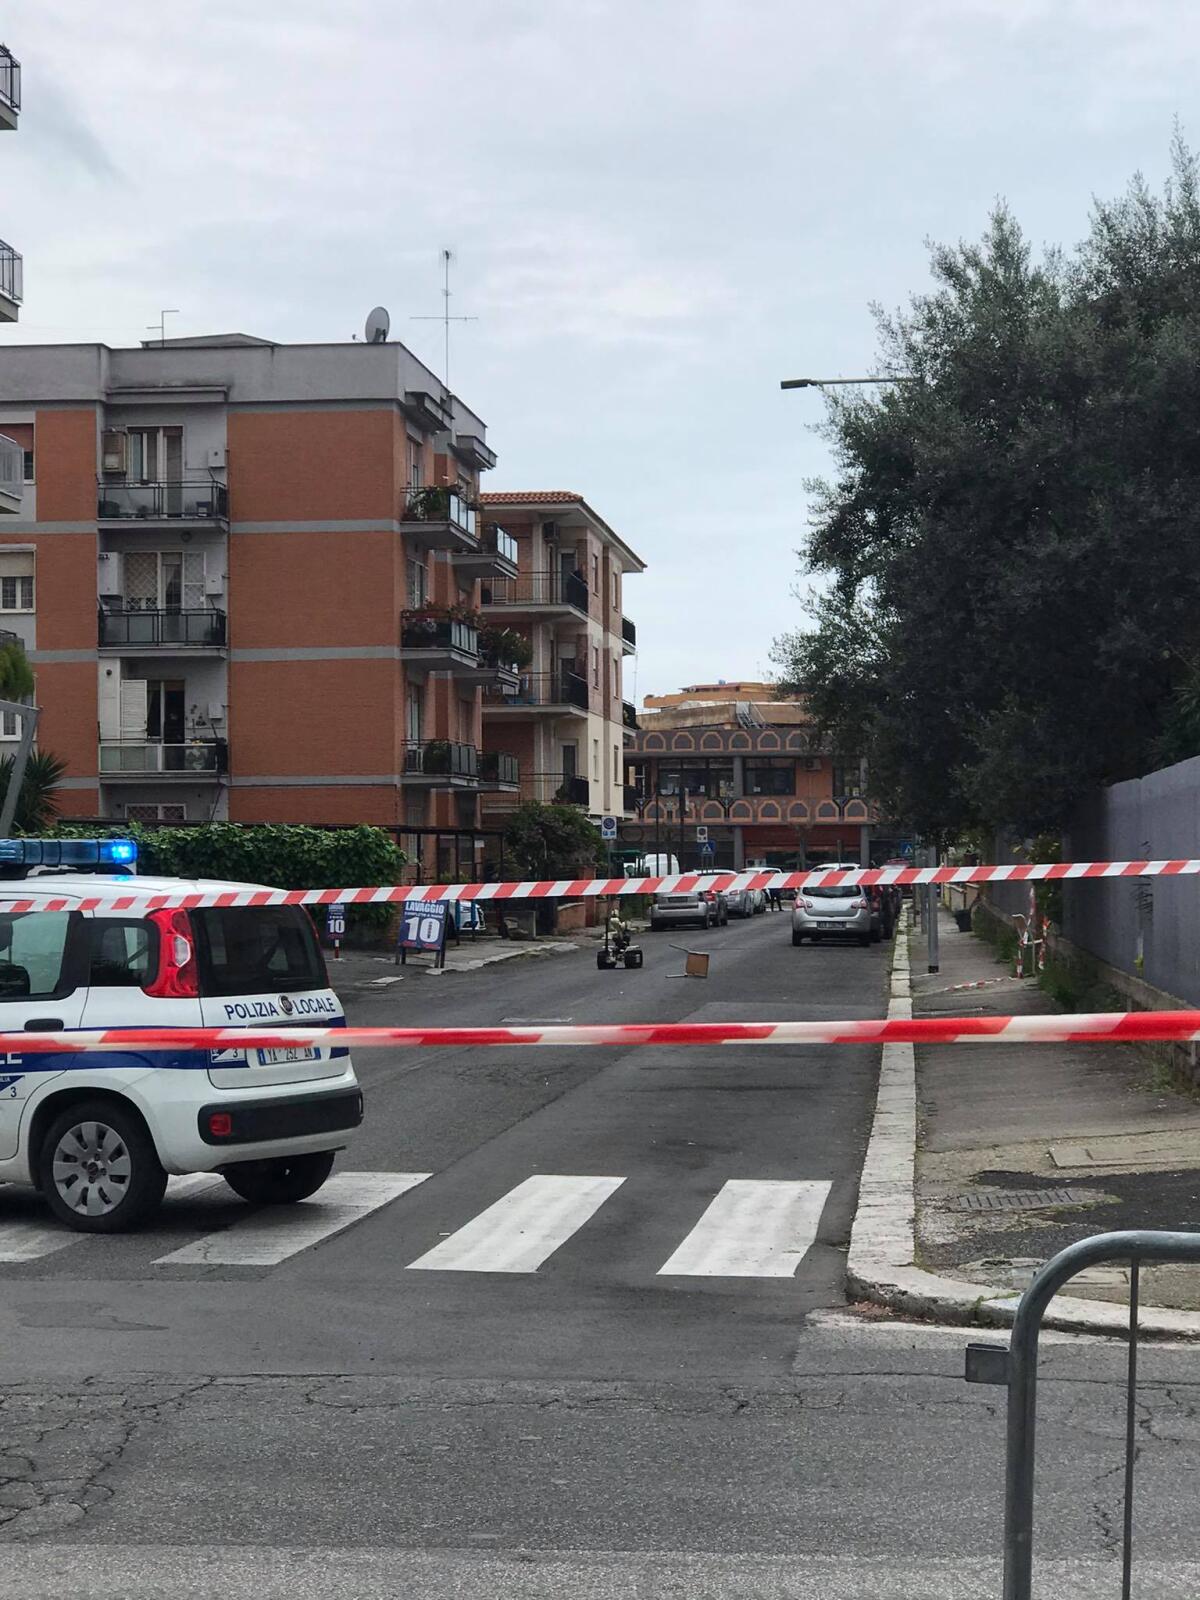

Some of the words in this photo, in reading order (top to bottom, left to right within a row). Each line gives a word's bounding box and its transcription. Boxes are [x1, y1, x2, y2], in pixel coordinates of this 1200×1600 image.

[405, 901, 445, 914] LAVAGGIO
[327, 919, 345, 934] 10
[405, 917, 440, 942] 10
[224, 1002, 280, 1019] POLIZIA
[294, 998, 335, 1014] LOCALE
[233, 1047, 238, 1058] 3
[10, 1086, 16, 1097] 3
